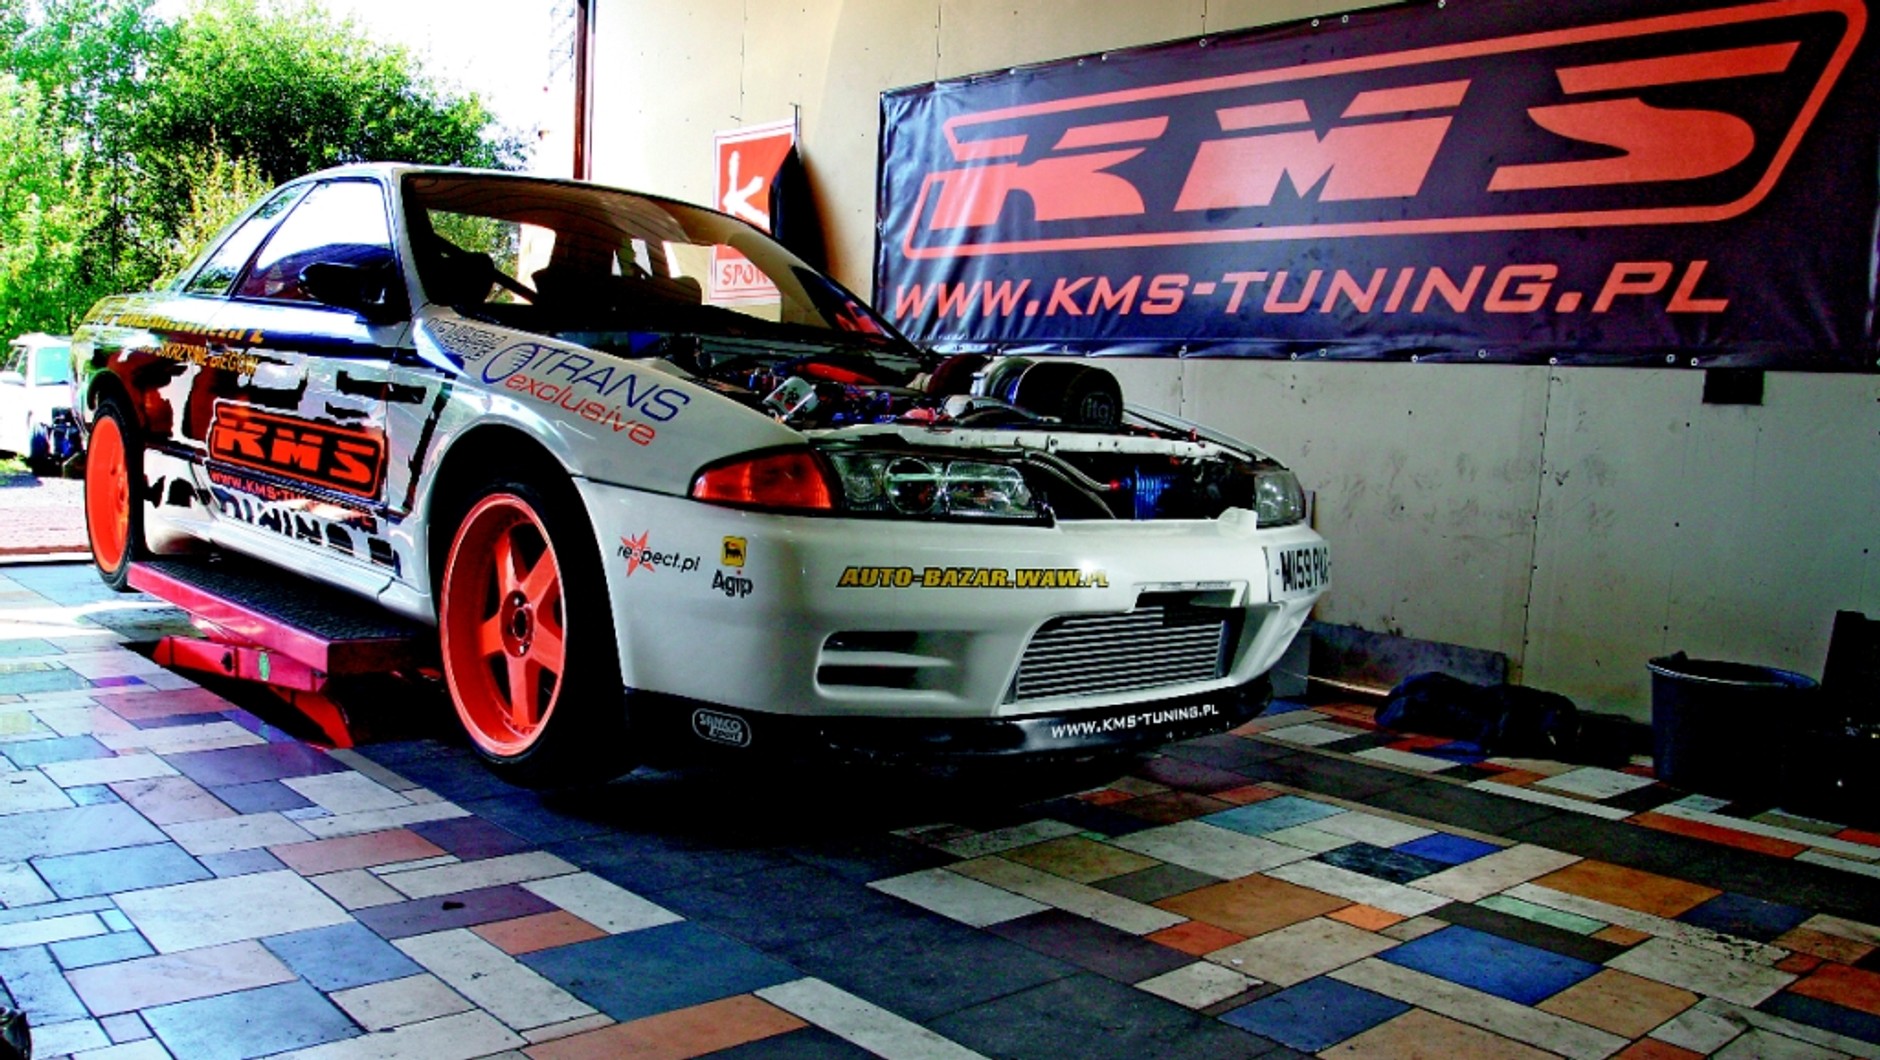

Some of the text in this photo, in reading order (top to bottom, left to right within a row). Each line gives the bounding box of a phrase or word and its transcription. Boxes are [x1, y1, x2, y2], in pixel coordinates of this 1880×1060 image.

[919, 41, 1800, 229] KMS
[895, 260, 1729, 319] WWW.KMS-TUNING.PL
[504, 372, 656, 447] exclusive
[215, 417, 376, 484] KMS
[711, 568, 754, 598] Agip
[836, 566, 1109, 589] AUTO-BAZAR.WAW.PL
[1051, 704, 1220, 739] WWW.KMS-TUNING.PL
